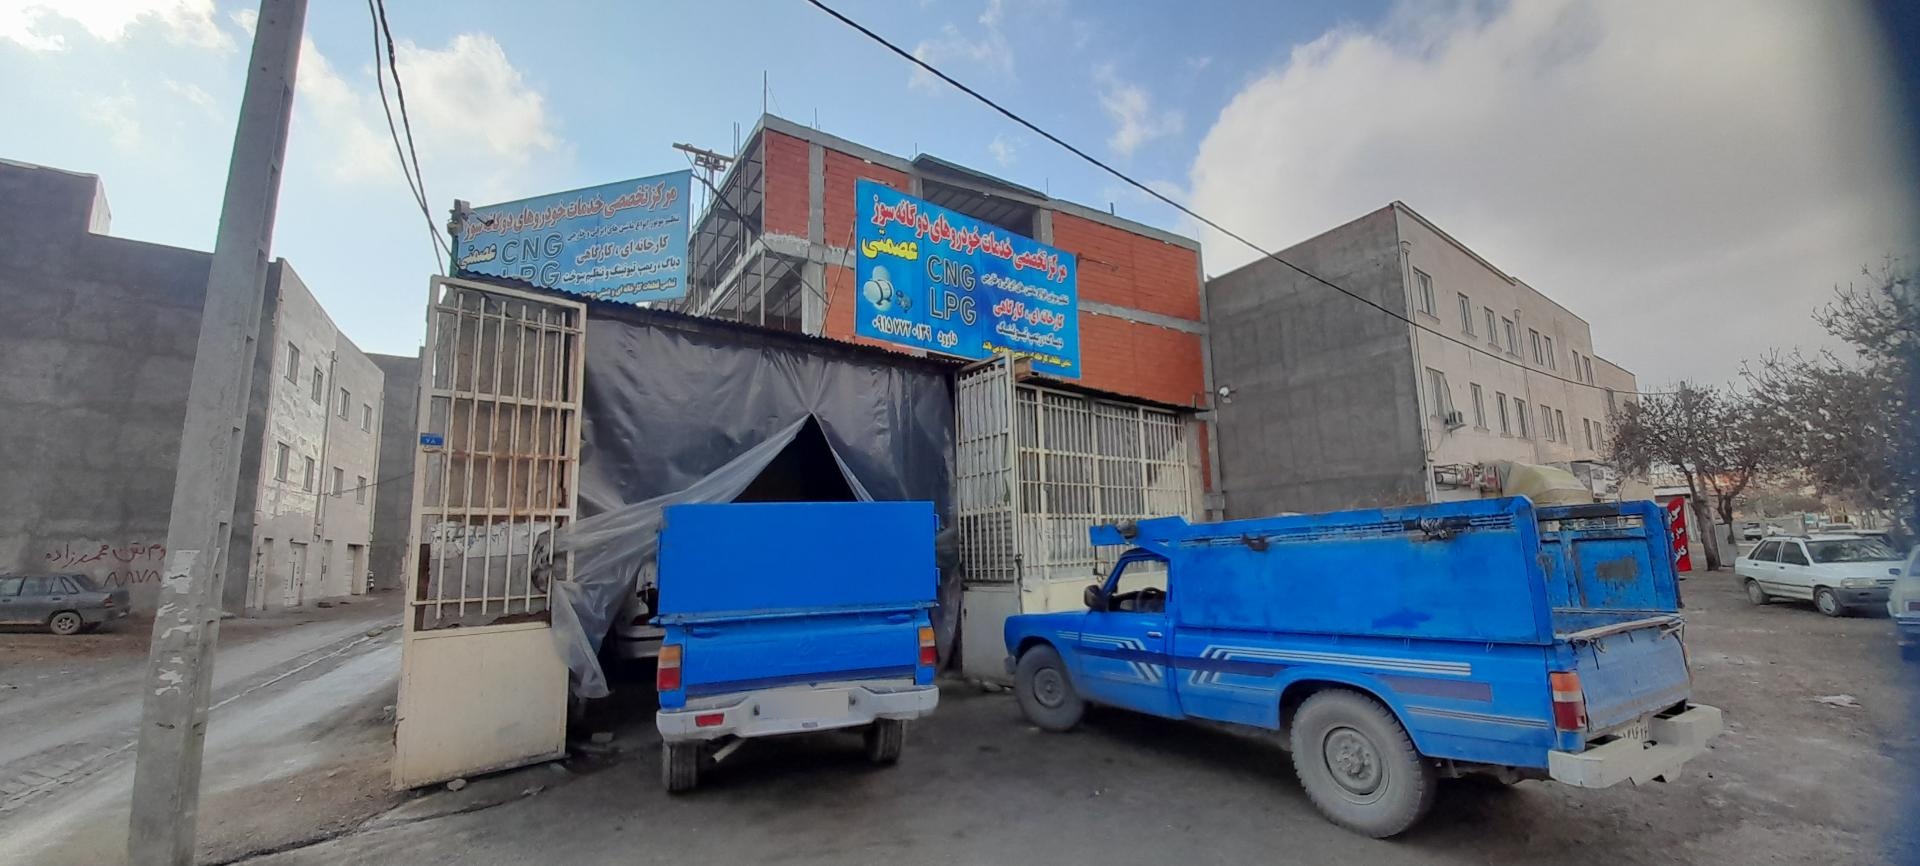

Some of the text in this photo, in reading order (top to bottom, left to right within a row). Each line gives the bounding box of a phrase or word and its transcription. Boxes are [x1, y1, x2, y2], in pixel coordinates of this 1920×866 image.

[567, 193, 604, 219] خدمات
[603, 184, 649, 219] تخصصی
[648, 181, 678, 212] مرکز
[871, 194, 896, 226] سوز
[501, 232, 564, 265] CNG
[576, 243, 614, 265] کارگاهی
[635, 236, 669, 254] کارخانه
[862, 229, 918, 260] عصمتی
[980, 236, 1013, 260] خدمات
[1013, 248, 1047, 271] تخصصی
[563, 269, 585, 285] سوخت
[927, 255, 976, 291] CNG
[1047, 254, 1068, 283] مرکز
[930, 287, 976, 325] LPG
